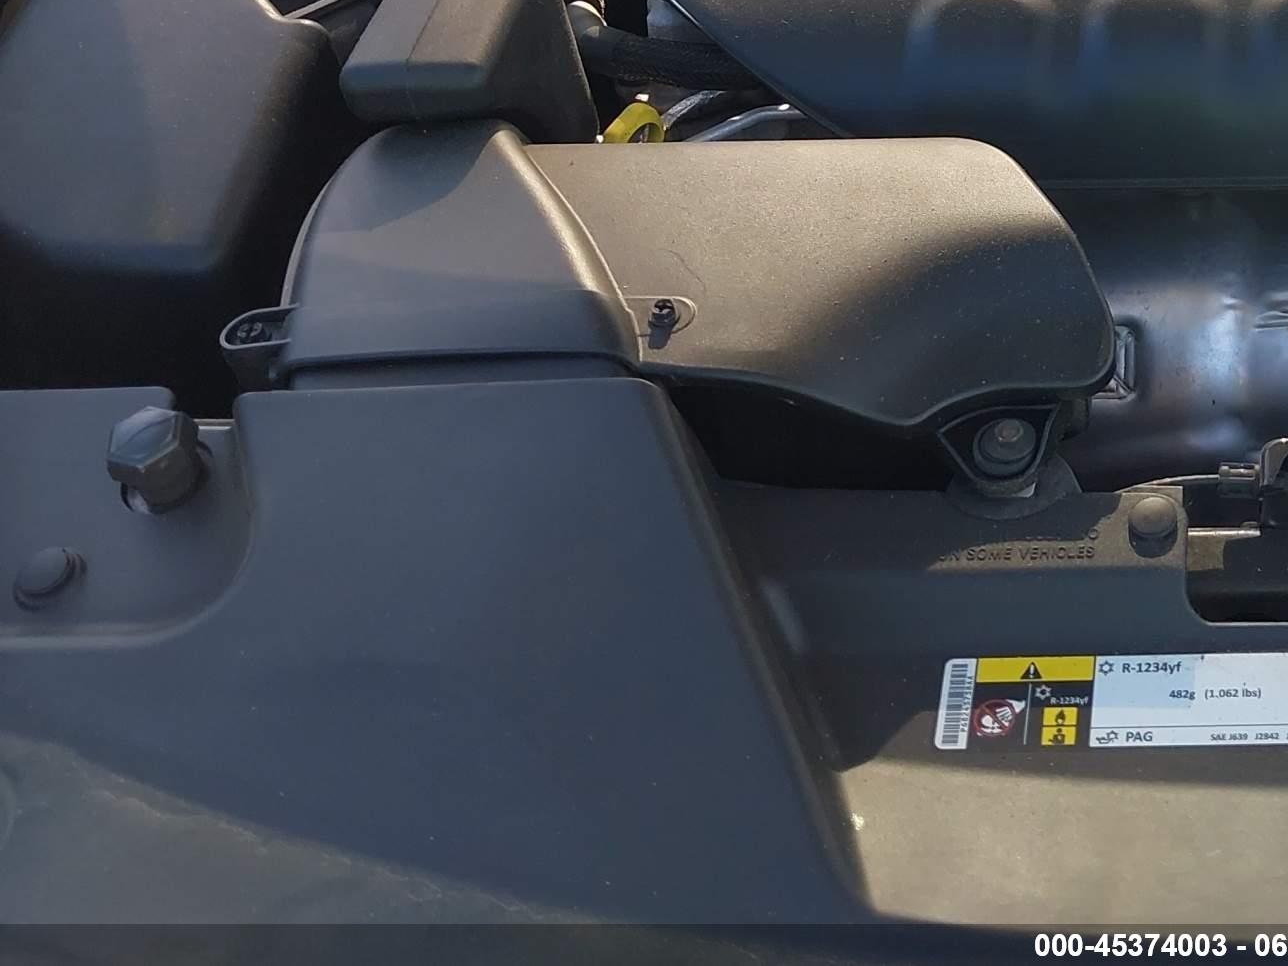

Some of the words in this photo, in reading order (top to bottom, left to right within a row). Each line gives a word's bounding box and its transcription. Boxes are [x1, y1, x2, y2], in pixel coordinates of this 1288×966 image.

[966, 547, 1013, 562] SOME
[1019, 545, 1096, 561] VEHICLES
[1121, 661, 1182, 675] R-1234yf
[1169, 689, 1196, 700] 482g
[1204, 688, 1239, 701] (1.062
[1241, 687, 1262, 700] lbs)
[1125, 730, 1154, 742] PAG
[1210, 733, 1227, 741] SAE
[1228, 732, 1249, 741] J639
